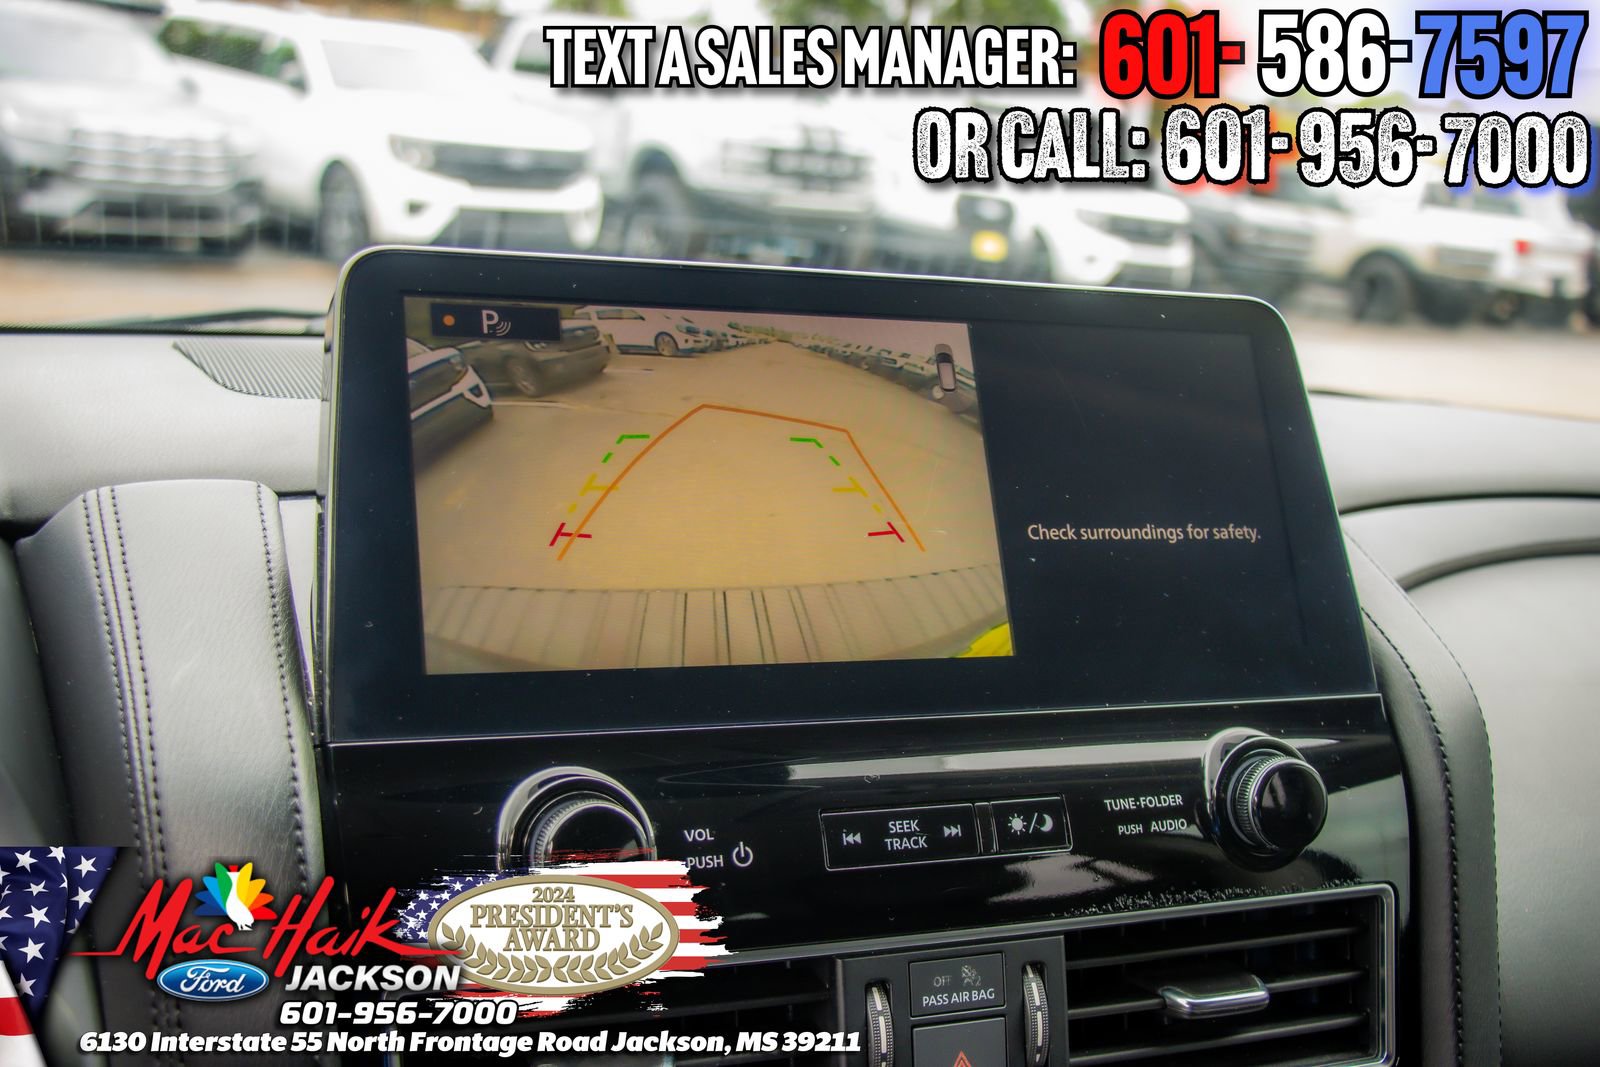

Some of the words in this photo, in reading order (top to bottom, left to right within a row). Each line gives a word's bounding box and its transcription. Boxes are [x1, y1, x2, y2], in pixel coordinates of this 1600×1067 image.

[1027, 523, 1076, 540] Check
[1080, 524, 1184, 543] surroundings
[1187, 524, 1209, 540] for
[1213, 524, 1261, 543] safety.
[888, 819, 920, 833] SEEK
[1118, 824, 1144, 835] PUSH
[1150, 818, 1187, 832] AUDIO
[684, 828, 715, 842] VOL
[884, 836, 928, 851] TRACK
[687, 854, 724, 869] PUSH
[922, 993, 949, 1007] PASS
[950, 991, 970, 1004] AIR
[972, 988, 995, 1001] BAG
